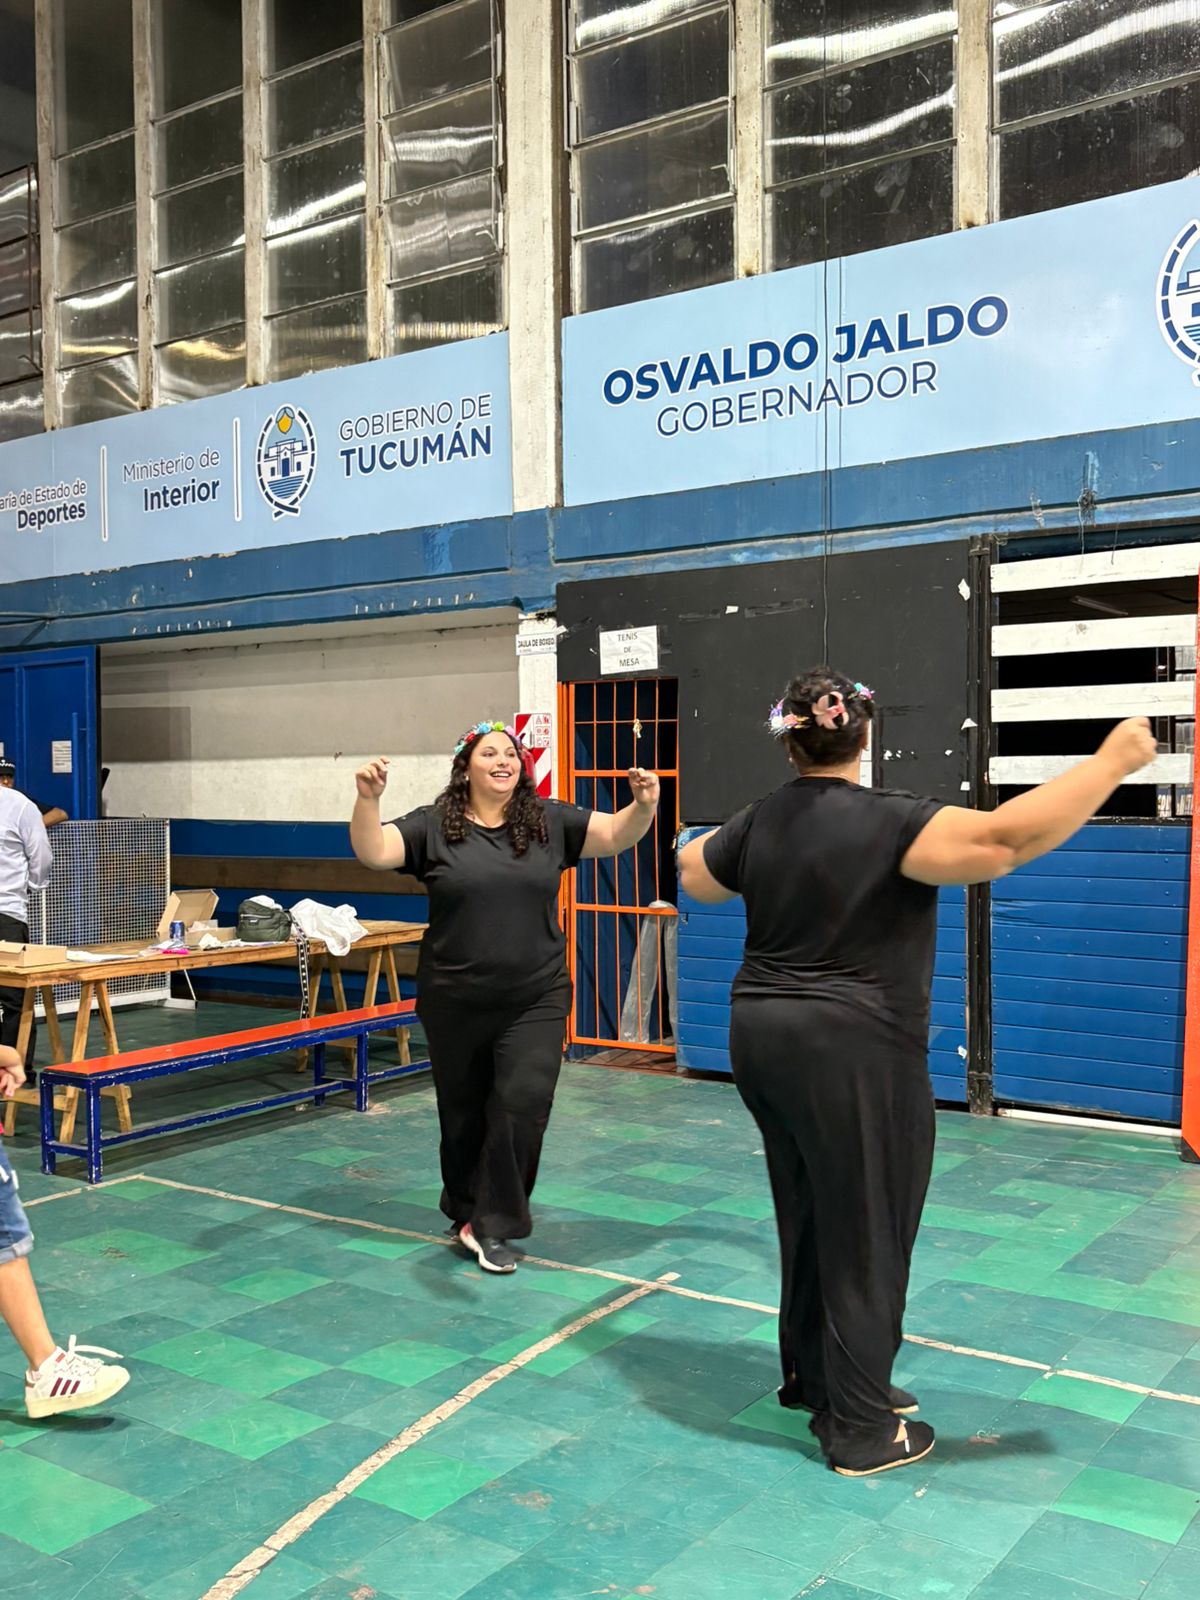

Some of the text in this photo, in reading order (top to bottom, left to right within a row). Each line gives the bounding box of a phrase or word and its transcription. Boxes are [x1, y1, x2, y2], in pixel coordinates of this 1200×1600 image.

[603, 296, 1008, 404] OSVALDO JALDO
[657, 360, 937, 436] GOBERNADOR
[340, 394, 491, 440] GOBIERNO DE
[123, 448, 219, 481] Ministerio de
[340, 421, 491, 476] TUCUMÁN
[20, 491, 32, 506] de
[35, 483, 70, 503] Estado
[73, 480, 86, 495] de
[144, 478, 220, 511] Interior
[18, 502, 86, 530] Deportes
[617, 632, 638, 641] TENIS
[619, 657, 640, 667] MESA
